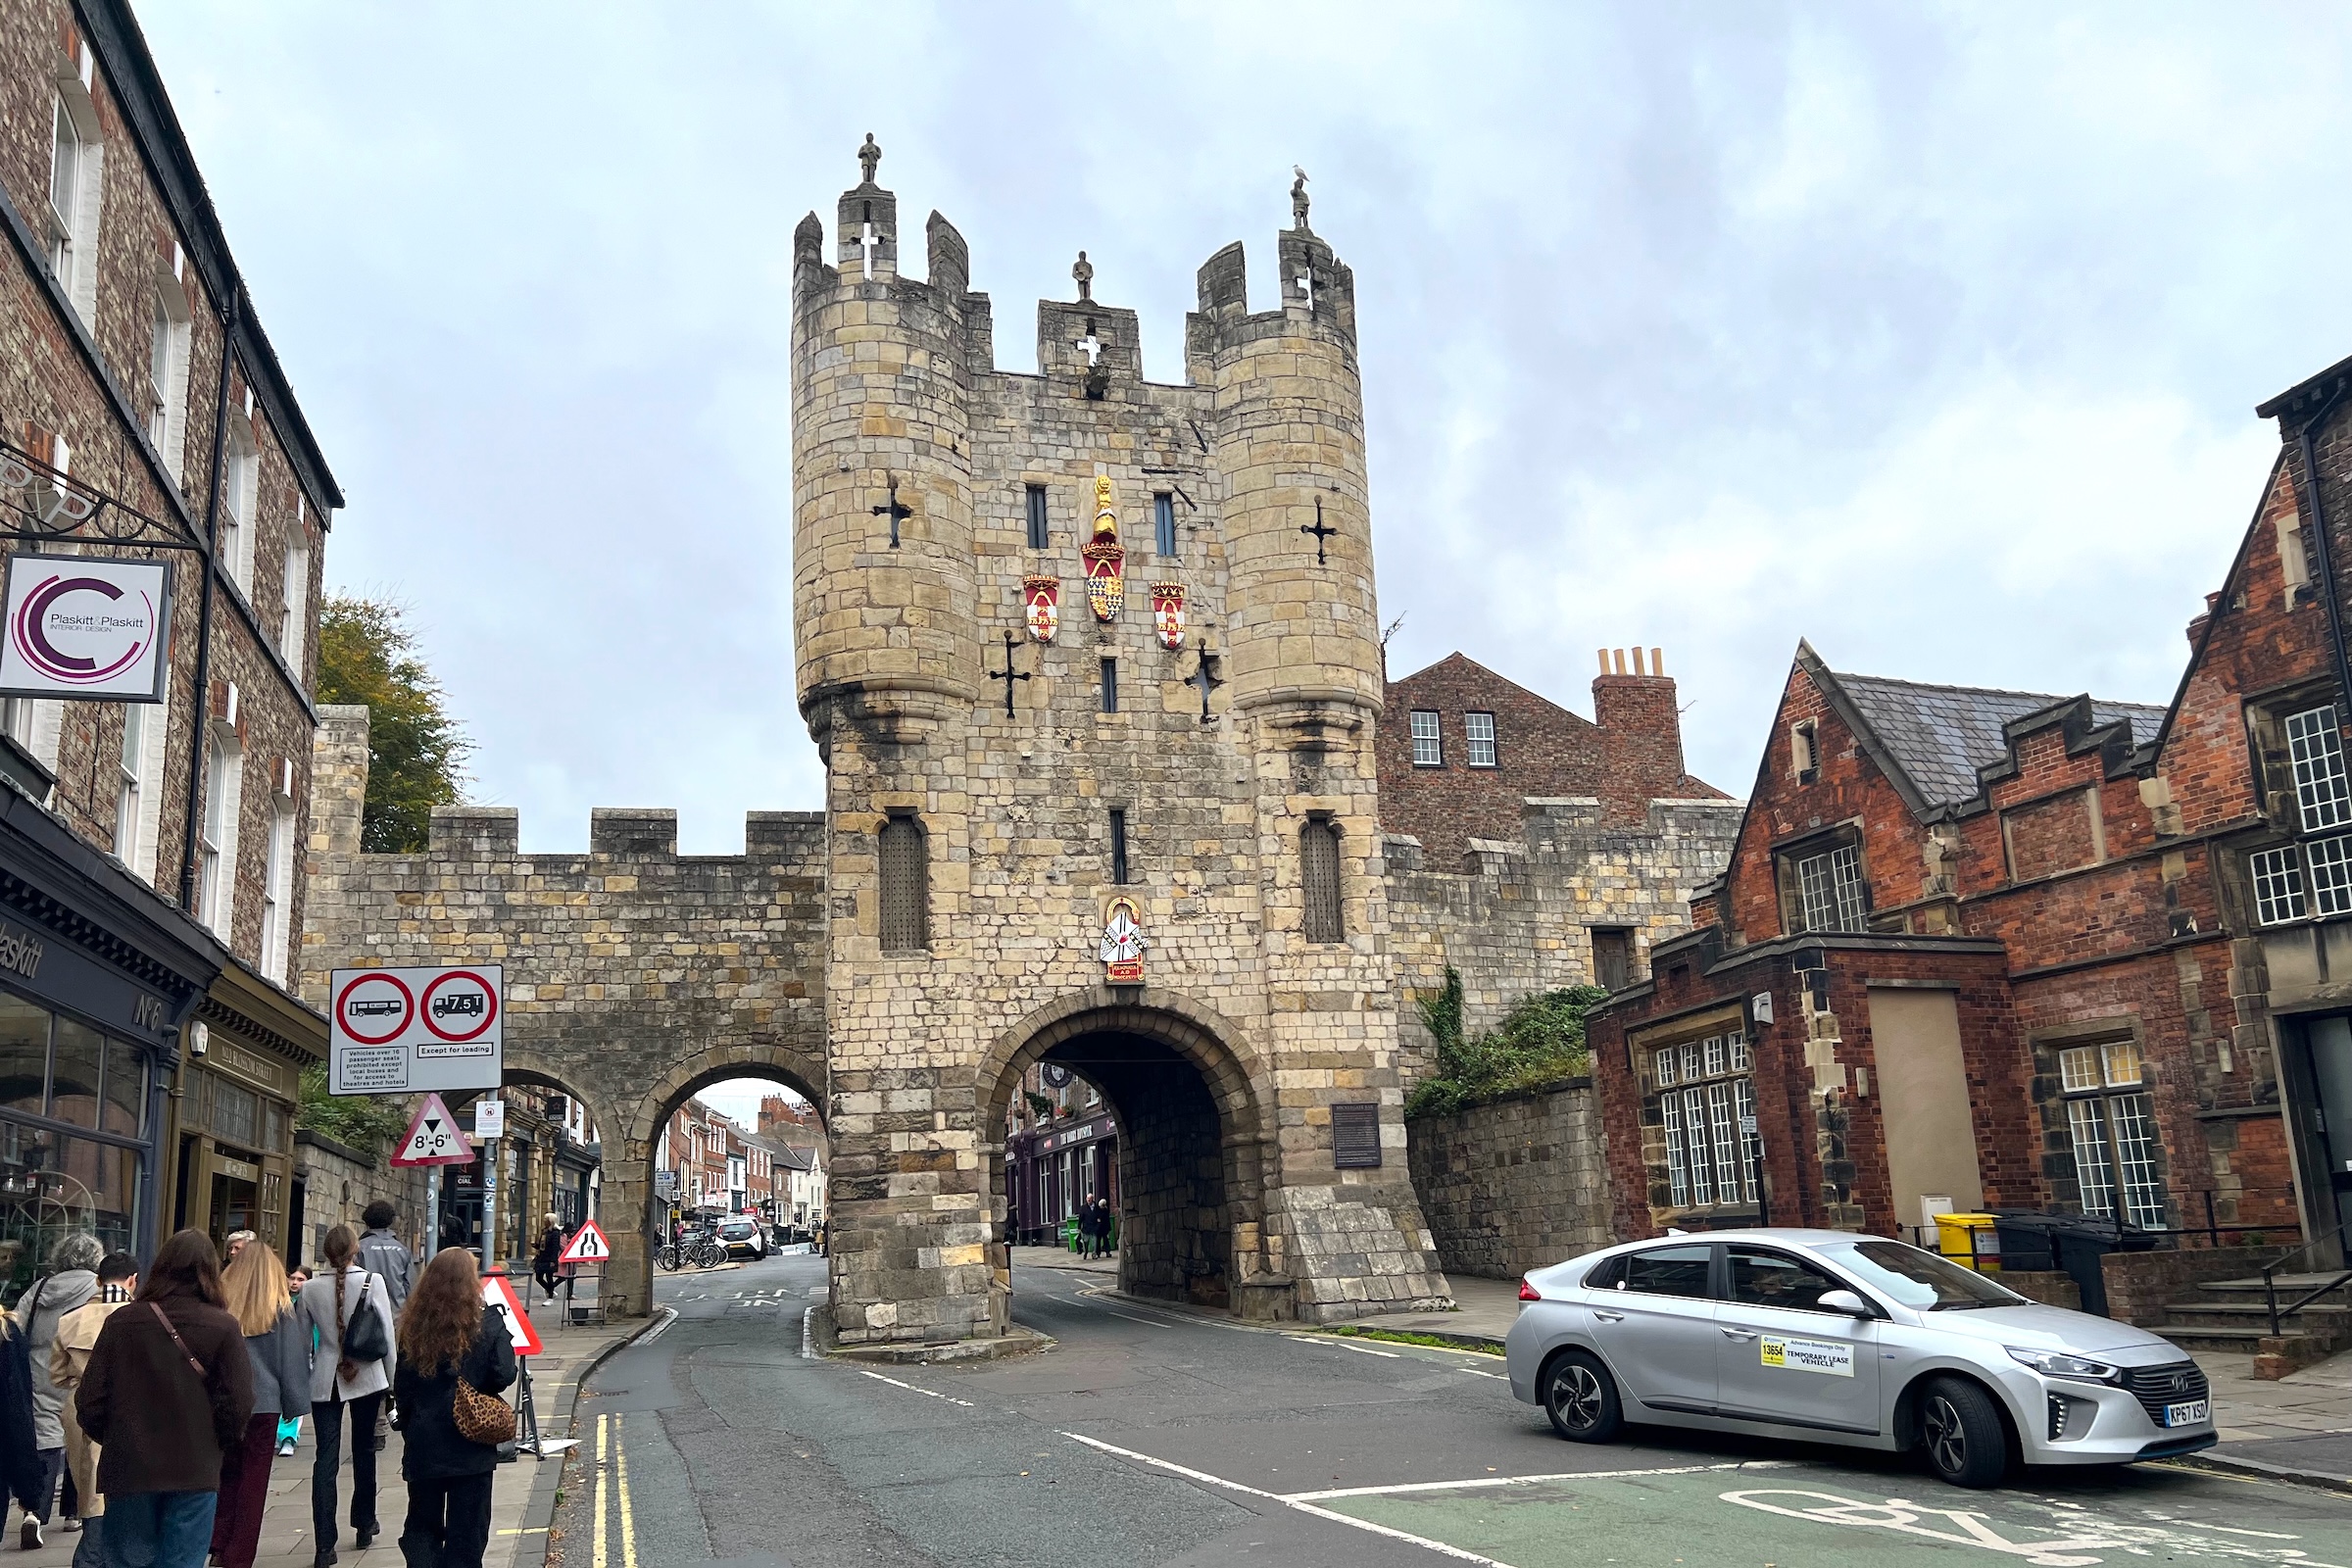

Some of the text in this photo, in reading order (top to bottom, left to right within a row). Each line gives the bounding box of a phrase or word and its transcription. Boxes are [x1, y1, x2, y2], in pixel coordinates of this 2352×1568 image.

[1763, 1345, 1783, 1356] 13654
[1811, 1342, 1834, 1350] Bookings
[1787, 1350, 1849, 1364] TEMPORARY LEASE
[1800, 1358, 1835, 1367] VEHICLE
[2170, 1402, 2206, 1423] KP67 XSD
